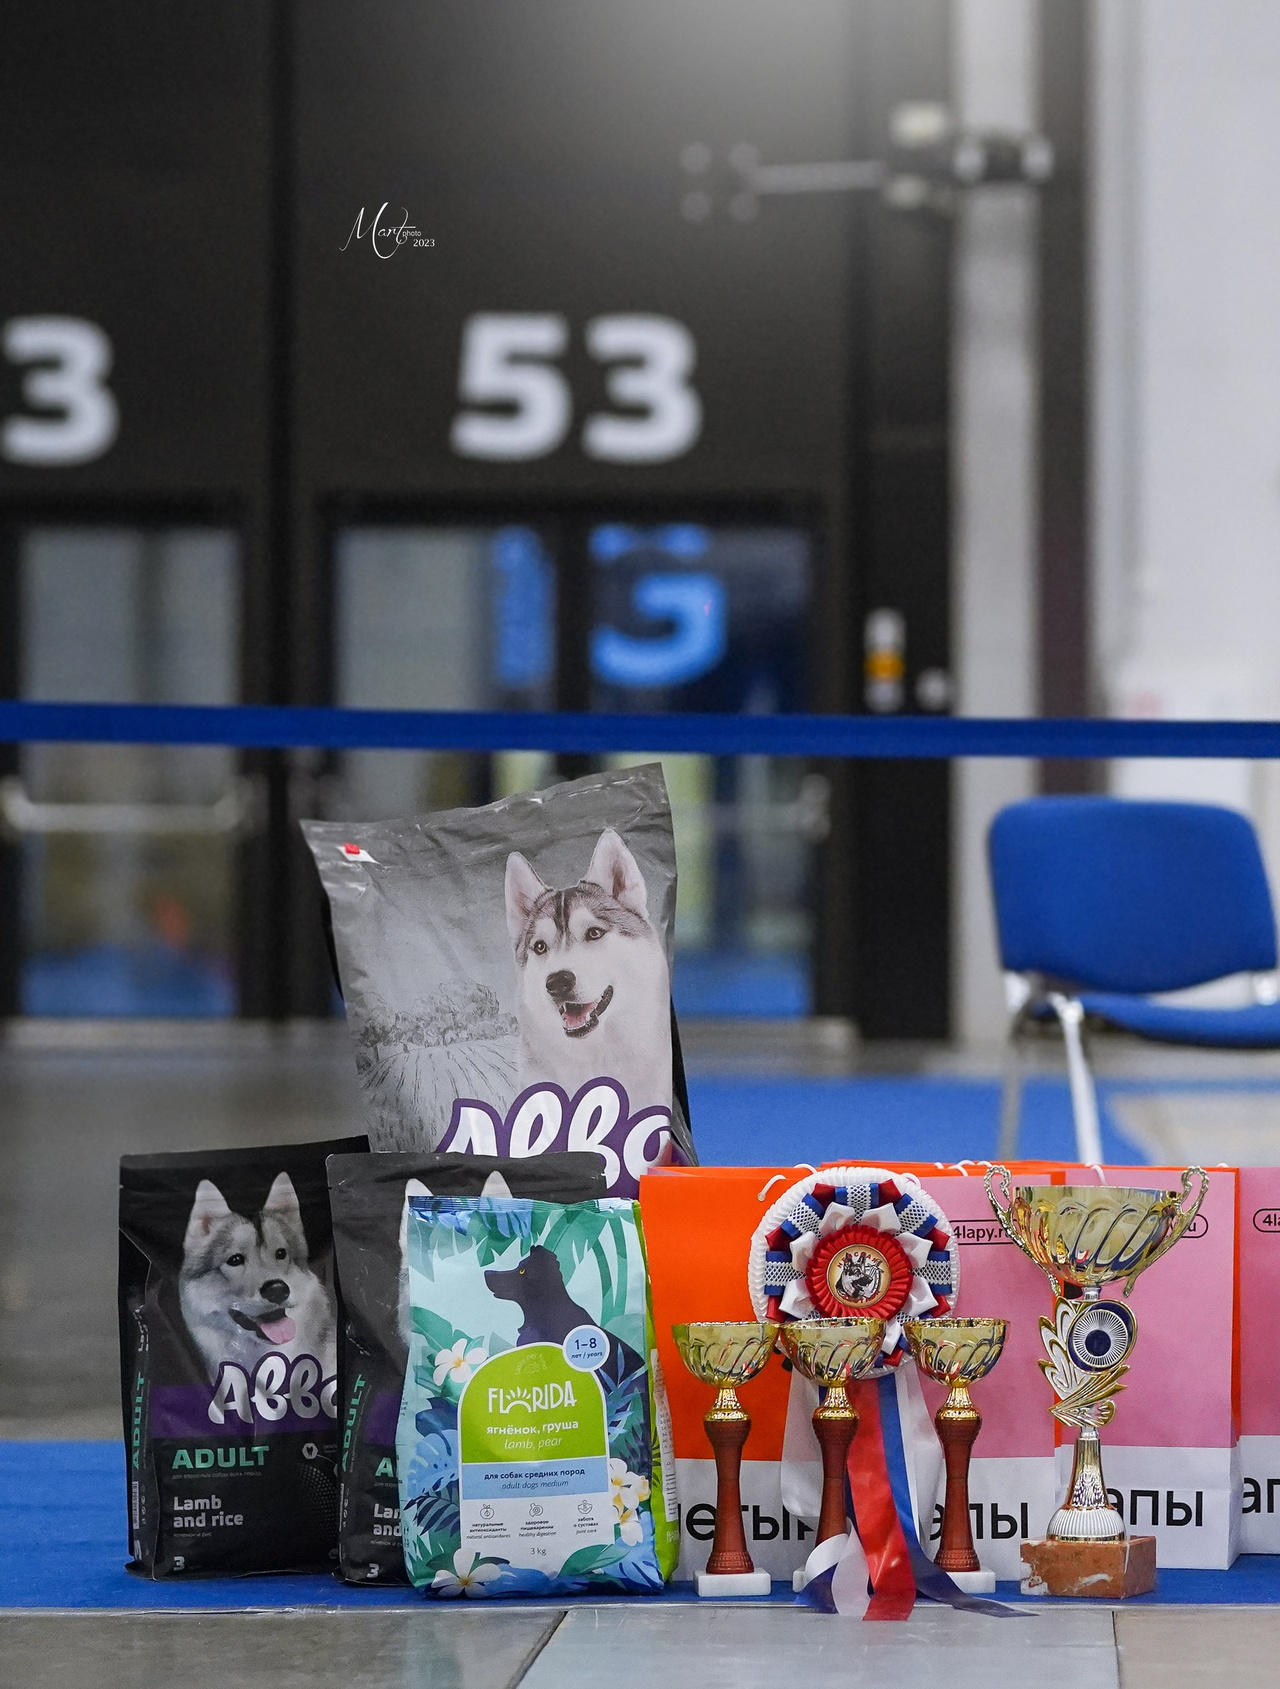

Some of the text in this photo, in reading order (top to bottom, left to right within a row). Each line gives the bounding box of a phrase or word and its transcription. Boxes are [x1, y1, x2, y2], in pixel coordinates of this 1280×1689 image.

[450, 312, 702, 465] 53
[953, 1225, 1010, 1241] 4lapy.r
[132, 1372, 145, 1469] ADULT
[341, 1374, 366, 1472] ADULT
[486, 1420, 579, 1435] ягнёнок, груша
[504, 1438, 562, 1450] lamb, pear
[171, 1446, 270, 1469] ADULT
[525, 1470, 558, 1479] средних
[560, 1469, 585, 1477] пород
[522, 1482, 539, 1490] dogs
[173, 1494, 222, 1510] Lamb
[1106, 1488, 1203, 1526] апы
[173, 1511, 244, 1527] and rice
[530, 1547, 546, 1556] 3 kg
[173, 1556, 185, 1571] 3
[366, 1563, 379, 1578] 3
